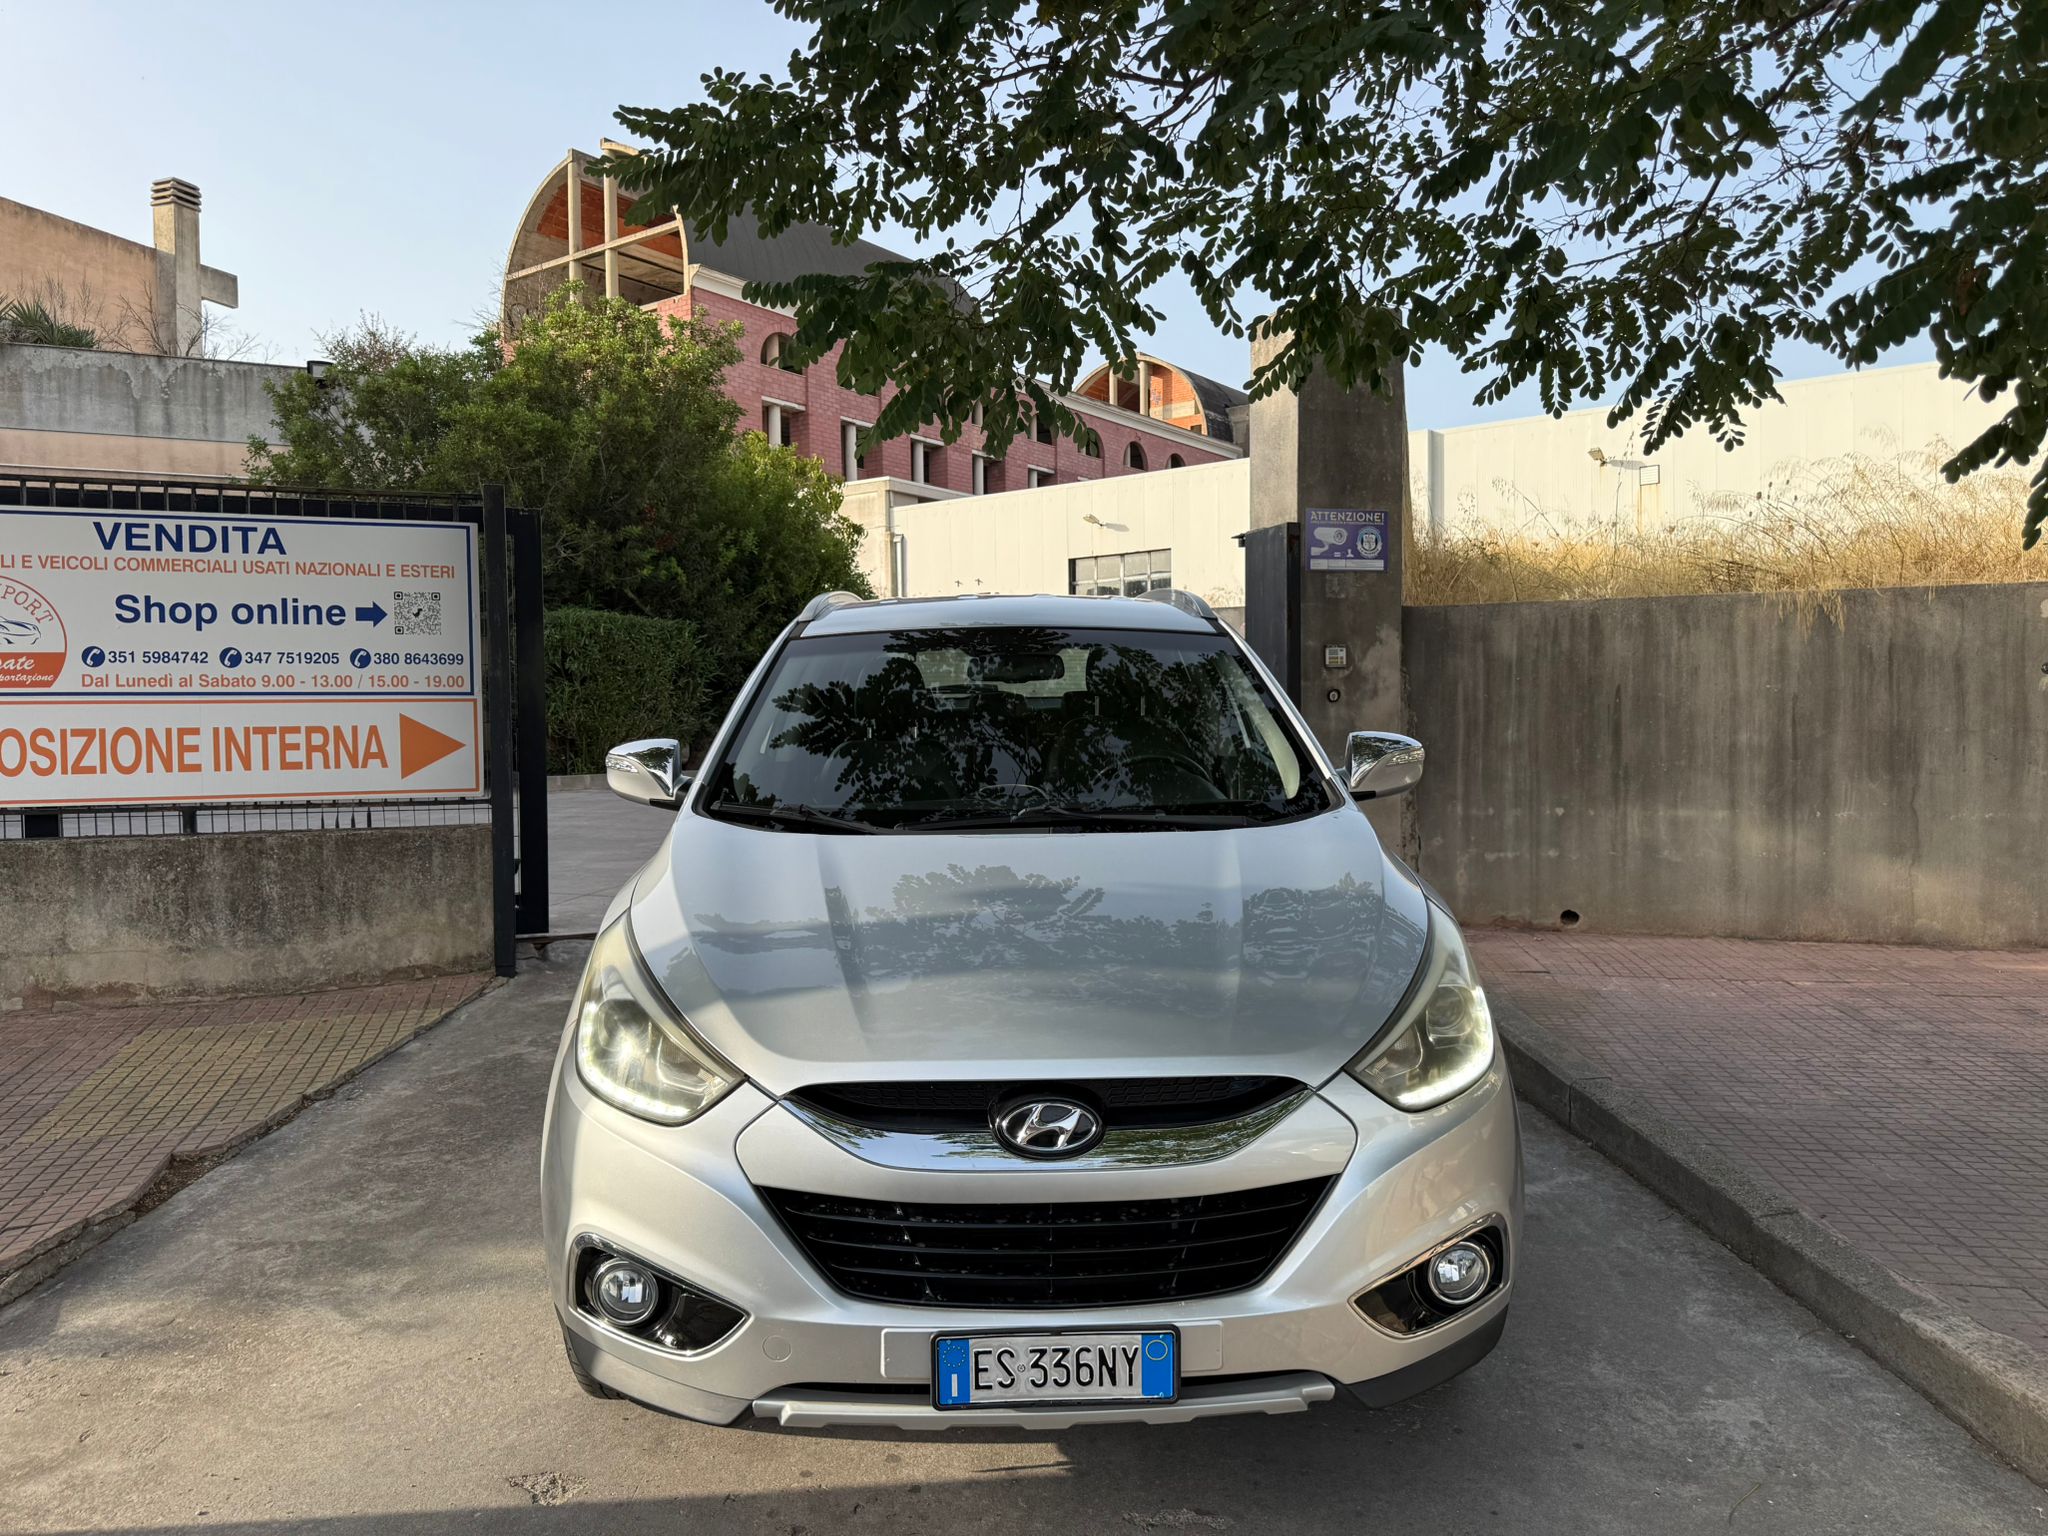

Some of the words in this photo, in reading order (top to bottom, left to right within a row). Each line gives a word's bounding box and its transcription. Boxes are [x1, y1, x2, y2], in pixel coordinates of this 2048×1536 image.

[1311, 511, 1385, 523] ATTENZIONE!
[93, 521, 287, 555] VENDITA
[21, 554, 33, 569] E
[38, 554, 108, 571] VEICOLI
[113, 556, 237, 574] COMMERCIALI
[243, 560, 290, 575] USATI
[295, 562, 381, 577] NAZIONALI
[386, 563, 396, 577] E
[400, 564, 455, 579] ESTERI
[0, 583, 54, 624] PORT
[115, 594, 217, 632] Shop
[231, 597, 346, 626] online
[0, 656, 35, 671] ate
[108, 650, 135, 664] 351
[142, 651, 209, 664] 5984742
[245, 652, 272, 664] 347
[277, 652, 340, 665] 7519205
[373, 653, 400, 666] 380
[404, 653, 464, 666] 8643699
[81, 673, 109, 688] Dal
[115, 673, 173, 688] Lunedì
[179, 674, 193, 688] al
[198, 674, 256, 688] Sabato
[261, 675, 295, 688] 9.00
[311, 675, 352, 688] 13.00
[368, 675, 409, 688] 15.00
[425, 675, 465, 688] 19.00
[0, 726, 202, 777] OSIZIONE
[212, 725, 389, 772] INTERNA
[973, 1348, 1016, 1390] ES
[1029, 1345, 1139, 1388] 336NY
